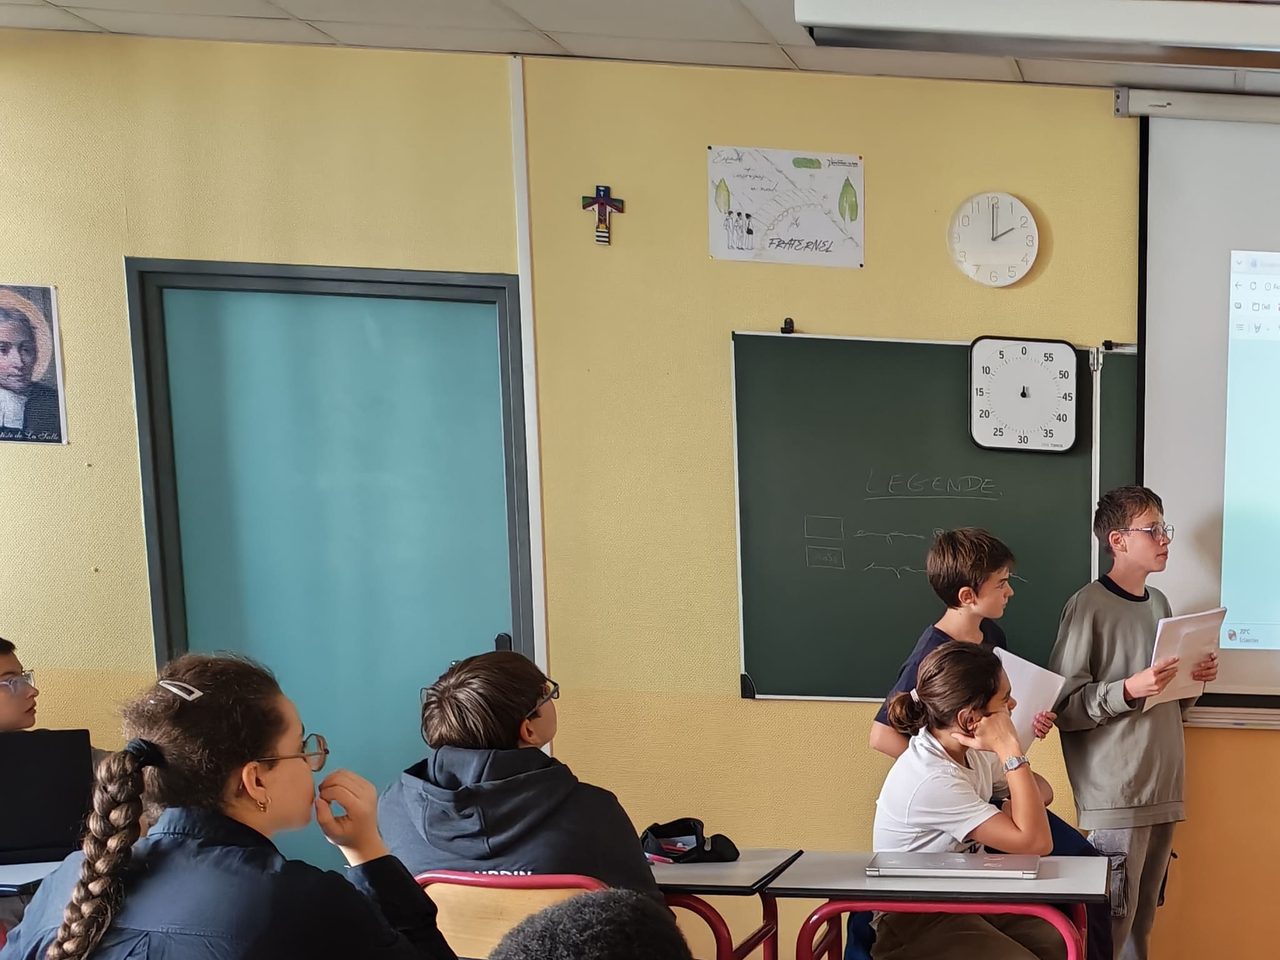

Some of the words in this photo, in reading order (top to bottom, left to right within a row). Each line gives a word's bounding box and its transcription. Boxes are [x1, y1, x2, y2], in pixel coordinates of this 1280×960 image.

[1020, 215, 1029, 228] 2
[768, 237, 833, 253] FRATERNEL
[1020, 253, 1030, 265] 4
[990, 270, 999, 282] 6
[1007, 265, 1017, 278] 5
[999, 350, 1004, 359] 5
[1021, 346, 1027, 355] 0
[1043, 352, 1054, 362] 55
[982, 365, 991, 375] 10
[1058, 370, 1069, 379] 50
[975, 387, 984, 397] 15
[1062, 392, 1073, 401] 45
[979, 409, 990, 418] 20
[1056, 413, 1067, 422] 40
[993, 427, 1004, 437] 25
[1043, 429, 1054, 438] 35
[1017, 435, 1028, 444] 30
